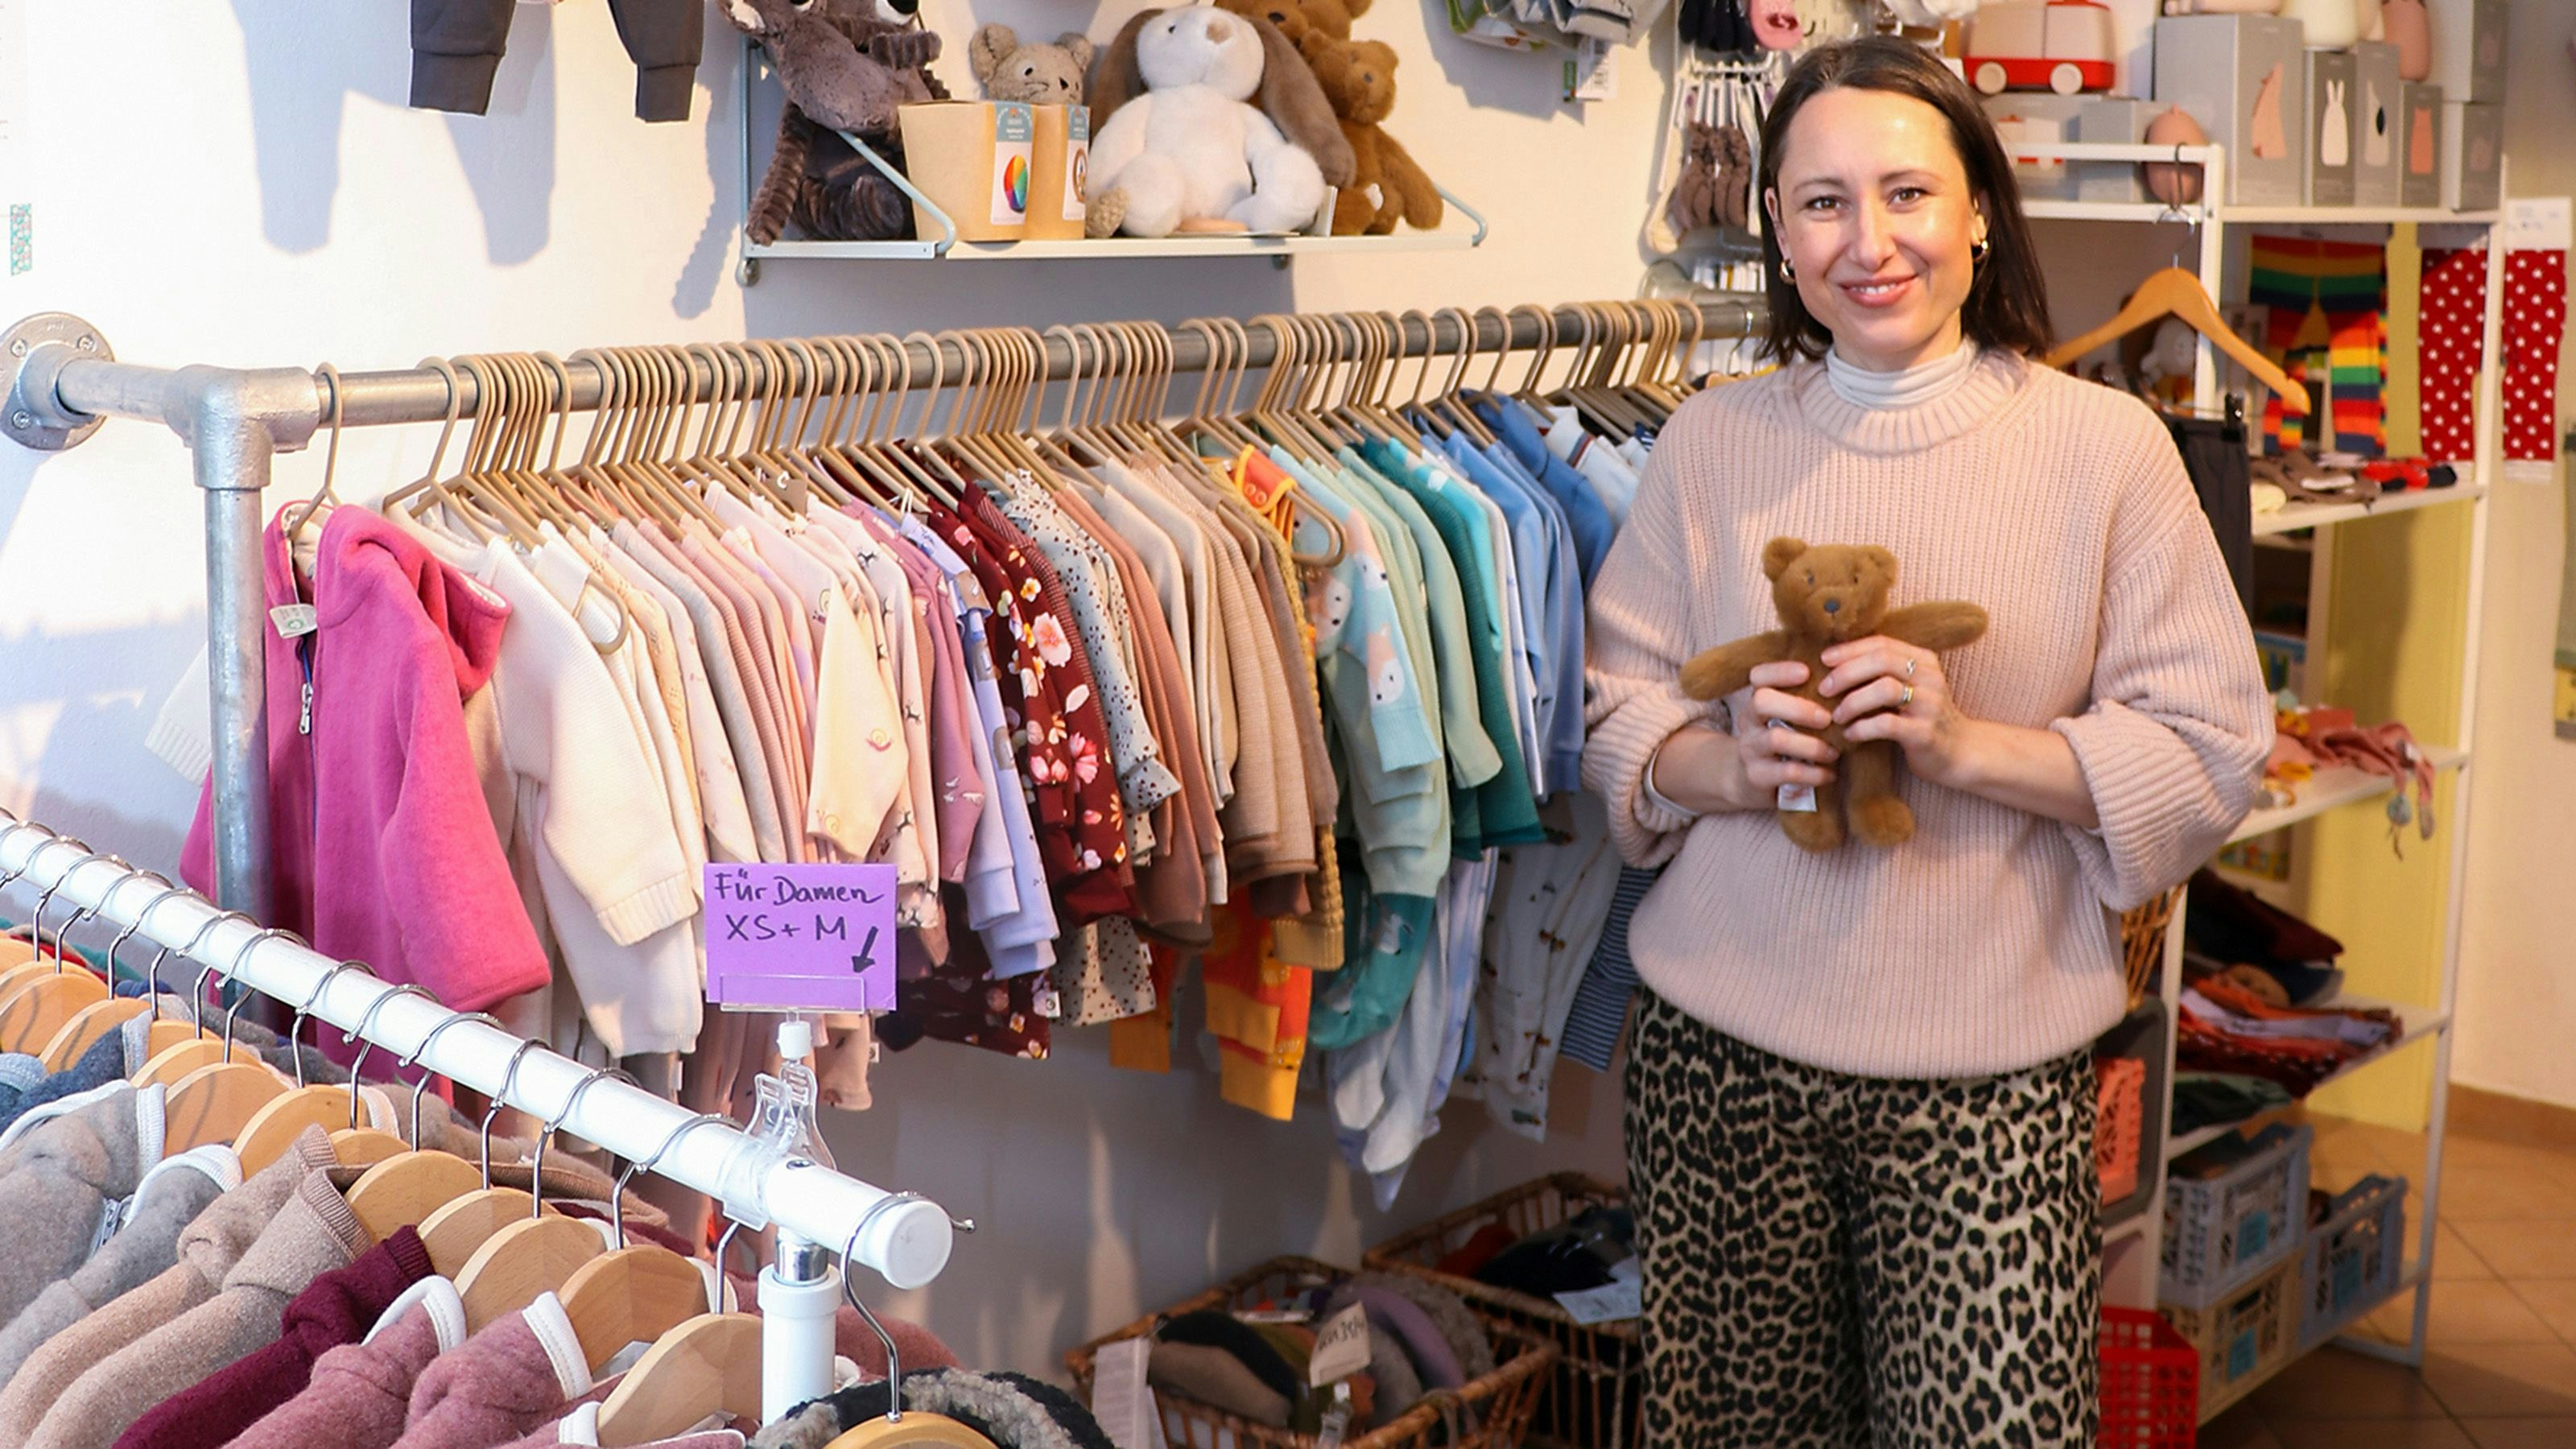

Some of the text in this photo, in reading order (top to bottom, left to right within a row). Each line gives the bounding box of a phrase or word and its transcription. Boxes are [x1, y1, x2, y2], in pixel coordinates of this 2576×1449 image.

[714, 868, 884, 906] Für Damen
[815, 914, 846, 940] M
